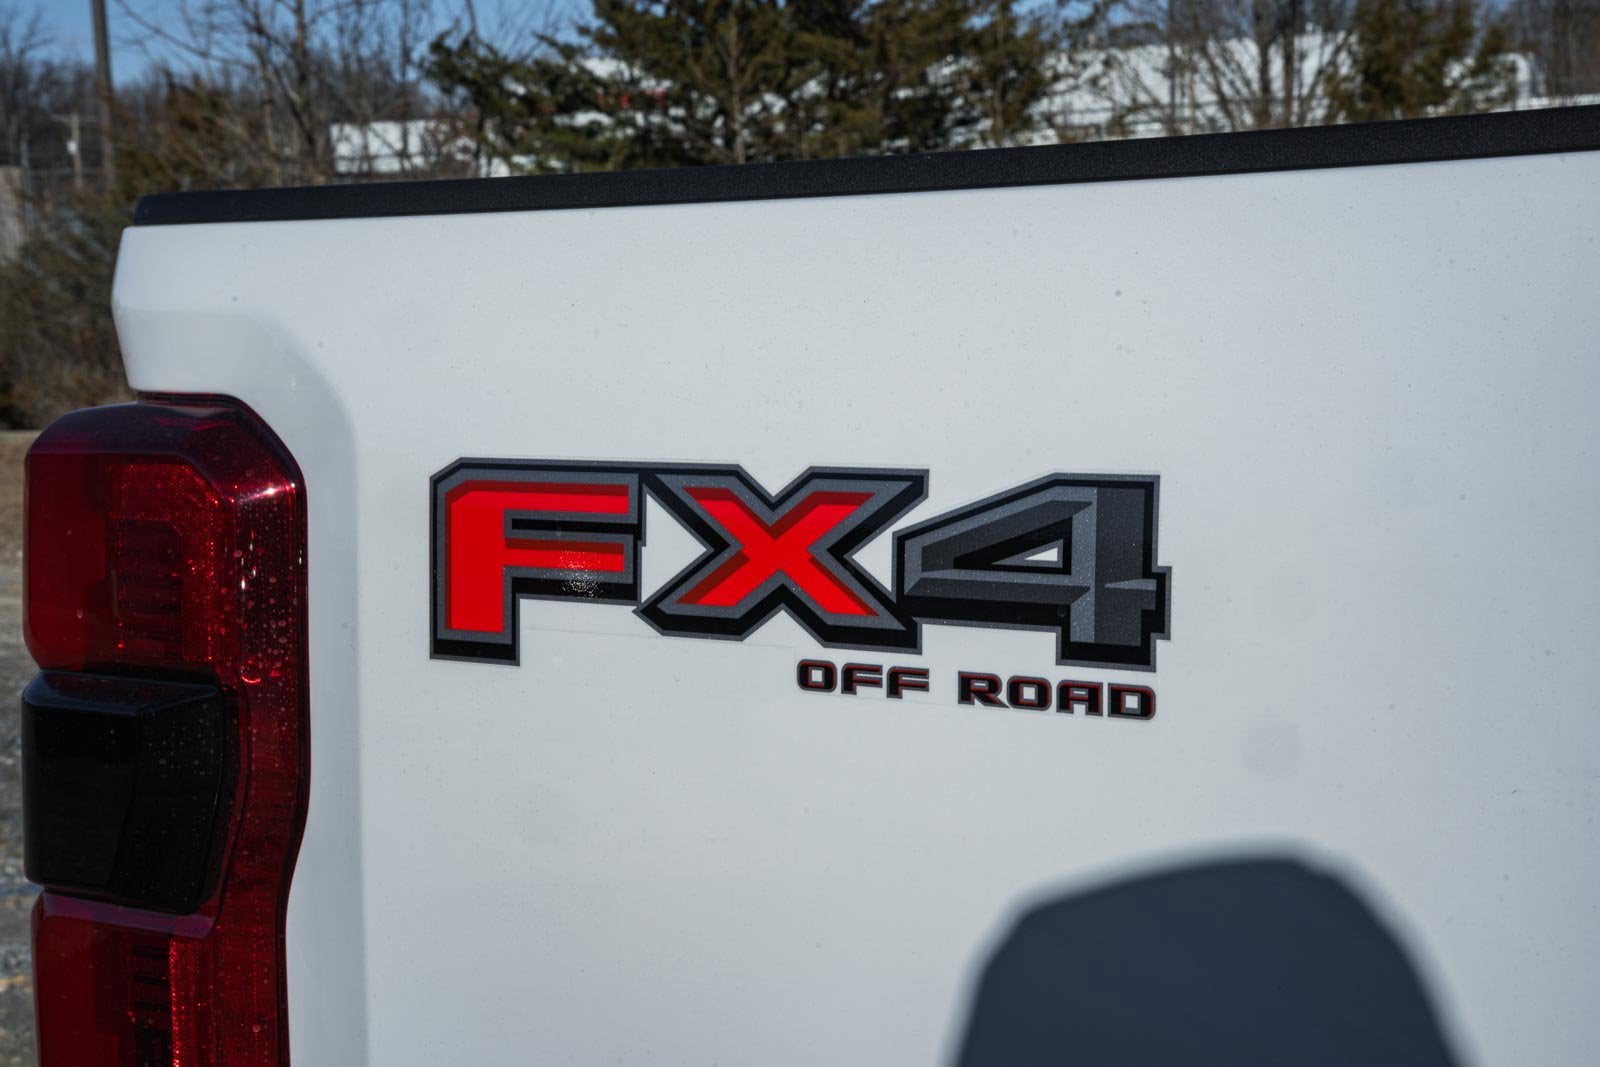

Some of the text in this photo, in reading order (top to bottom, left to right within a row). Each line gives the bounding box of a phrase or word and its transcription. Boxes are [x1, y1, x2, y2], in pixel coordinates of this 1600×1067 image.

[430, 457, 1171, 671] FX4
[797, 659, 1157, 721] OFF ROAD
